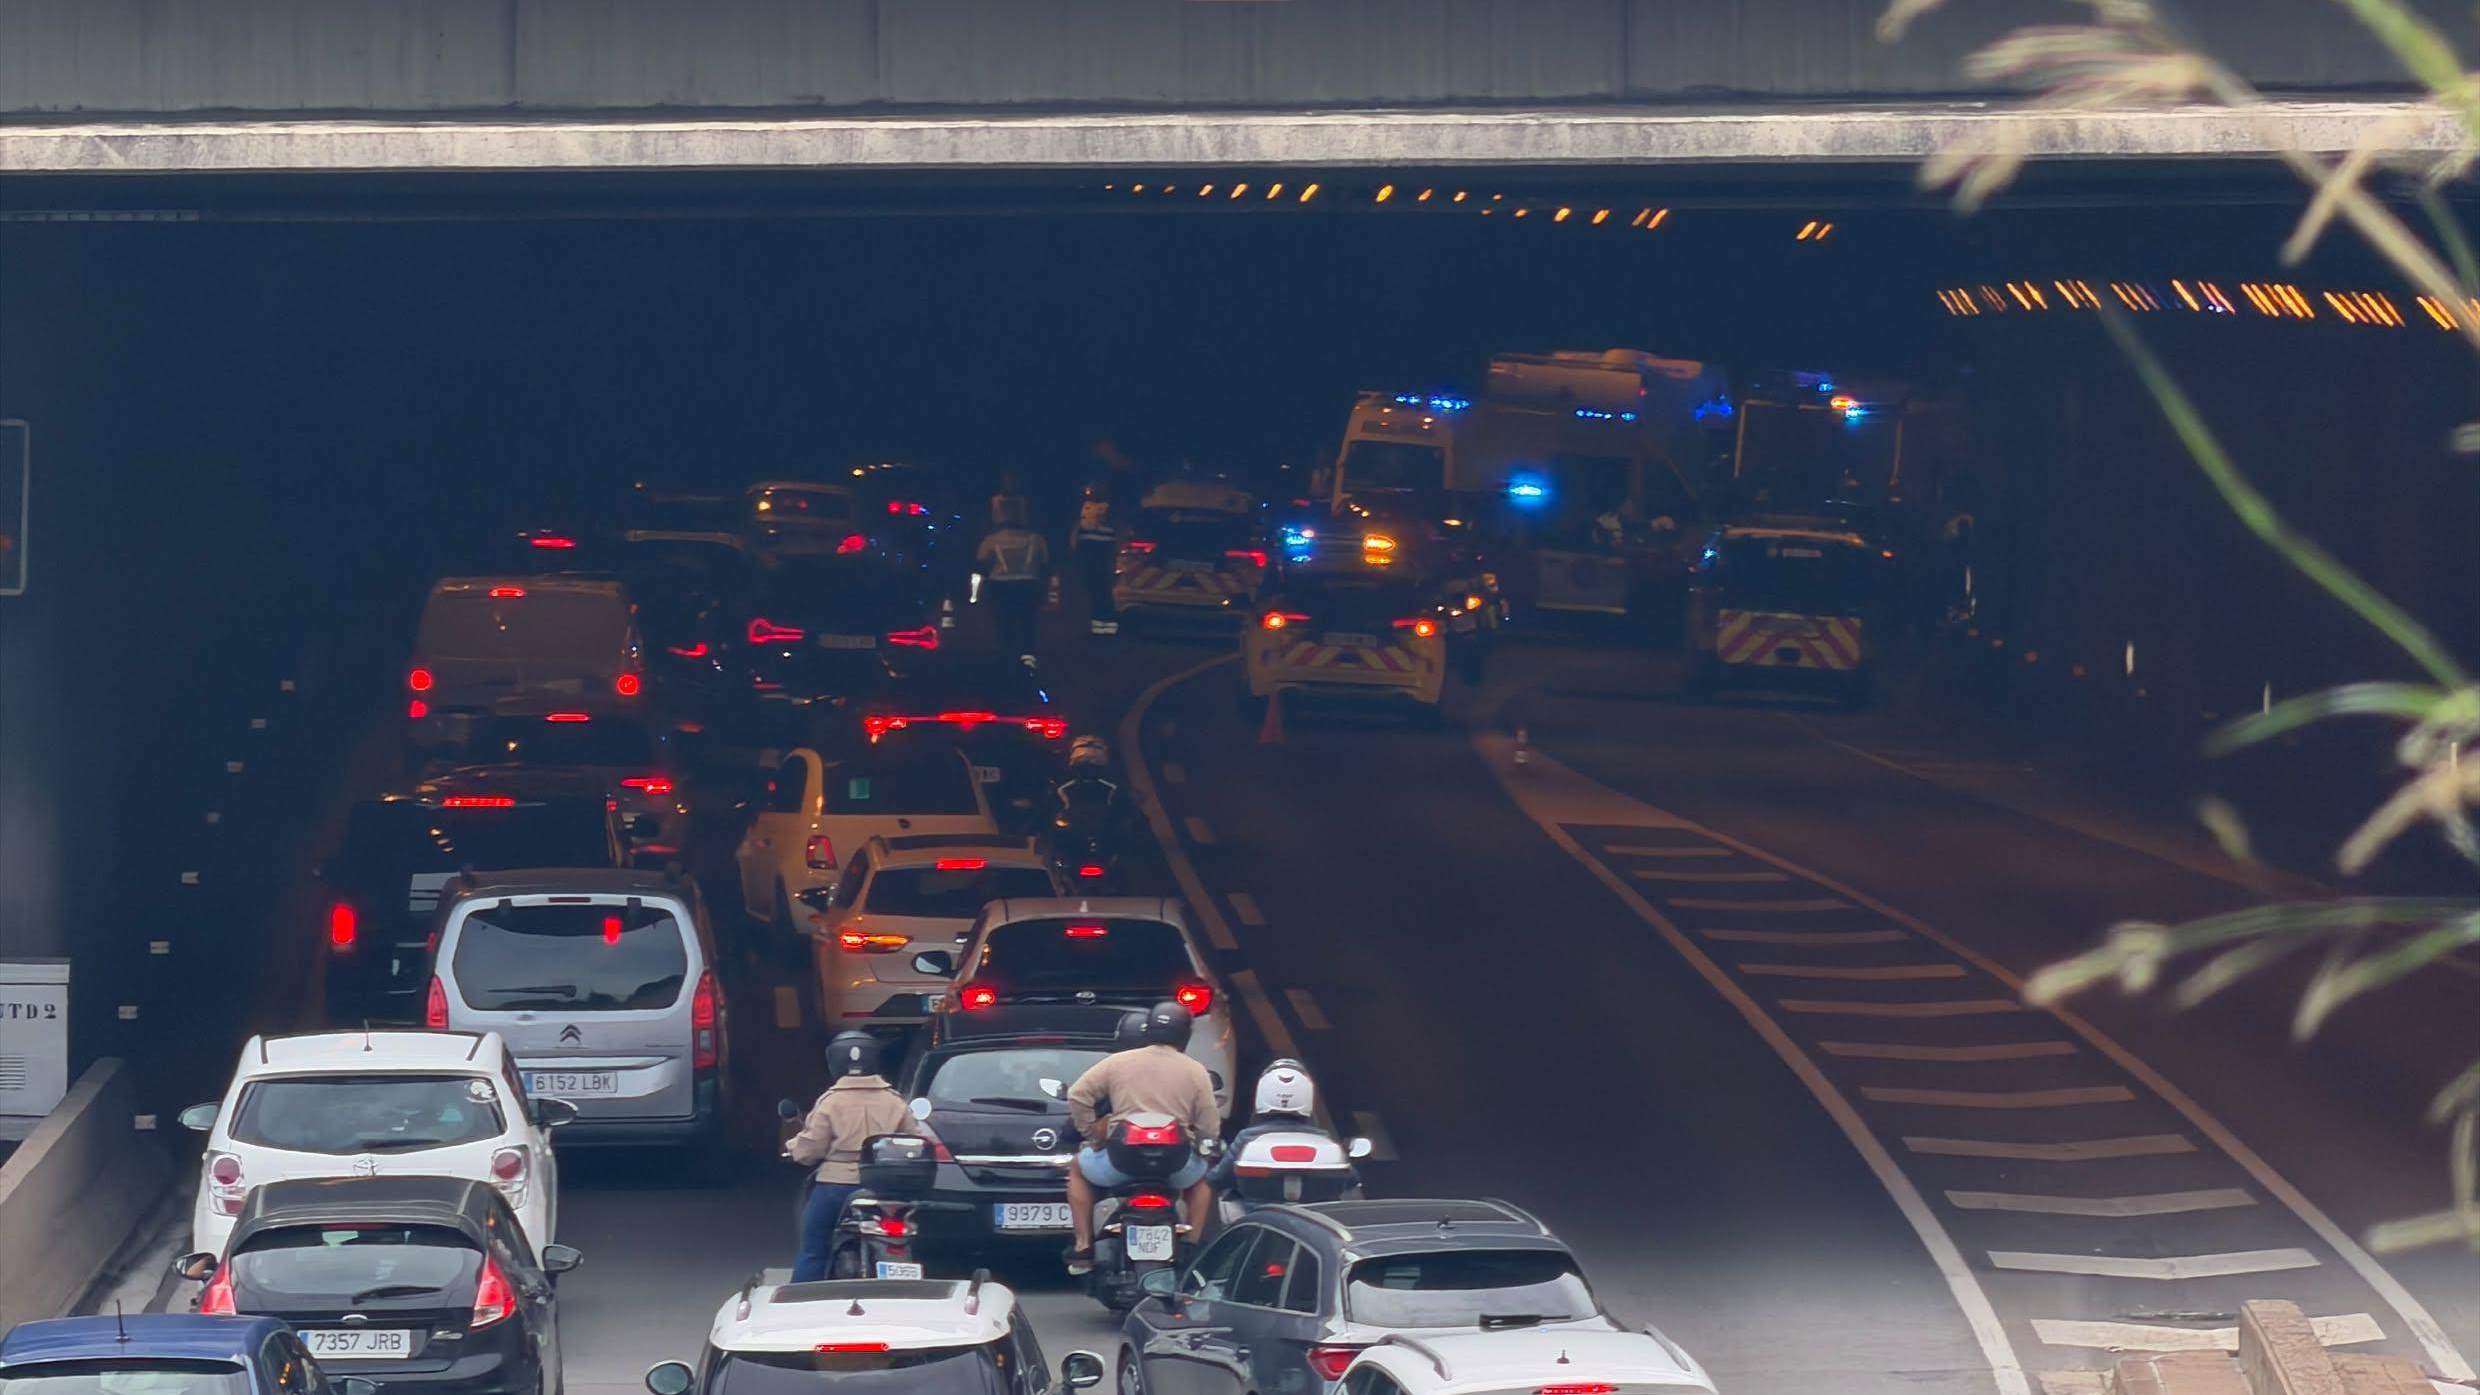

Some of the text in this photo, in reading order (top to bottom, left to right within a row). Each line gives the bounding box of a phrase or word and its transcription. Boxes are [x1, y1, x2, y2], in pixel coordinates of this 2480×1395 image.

[536, 1075, 611, 1091] 6152 LBK
[1008, 1206, 1052, 1221] 9979
[315, 1333, 402, 1350] 7357 JRB
